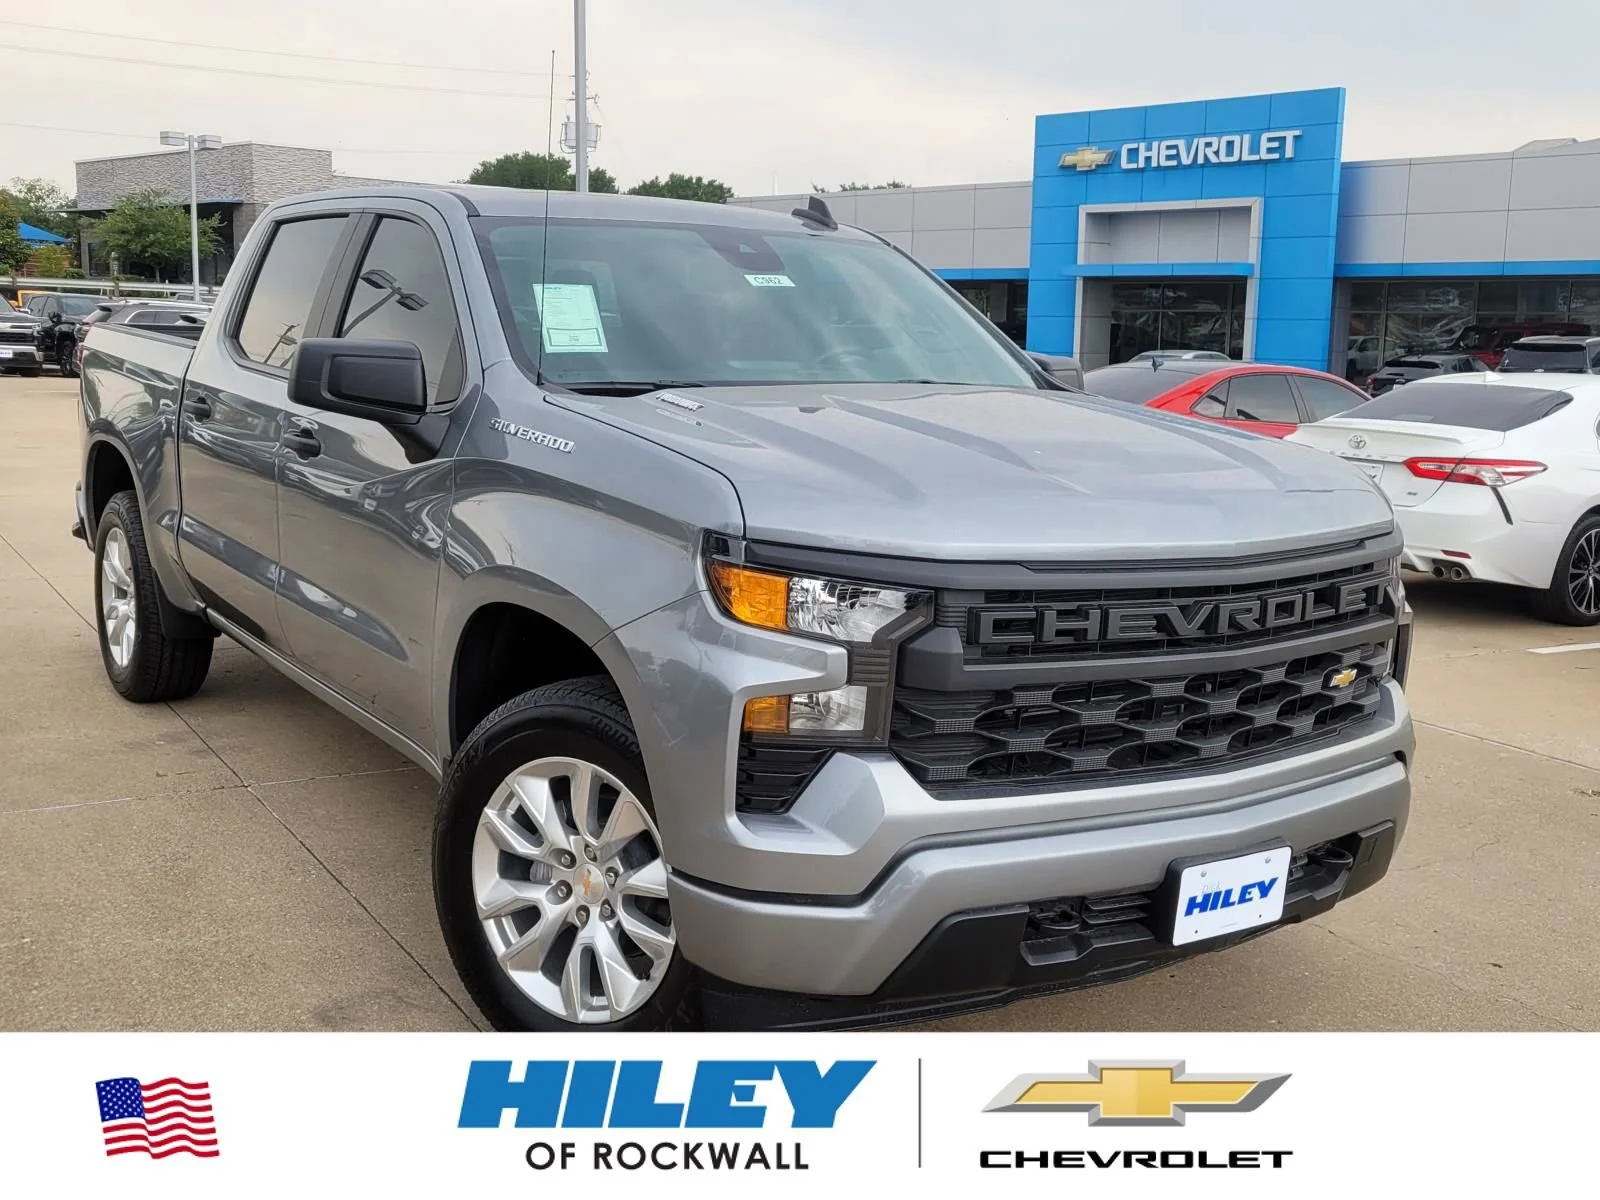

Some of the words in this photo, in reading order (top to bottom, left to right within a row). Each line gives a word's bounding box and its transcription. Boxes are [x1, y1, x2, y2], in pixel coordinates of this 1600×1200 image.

[1120, 130, 1302, 169] CHEVROLET
[491, 418, 575, 453] SILVERADO
[968, 577, 1392, 644] CHEVROLET
[1184, 877, 1279, 917] HILEY
